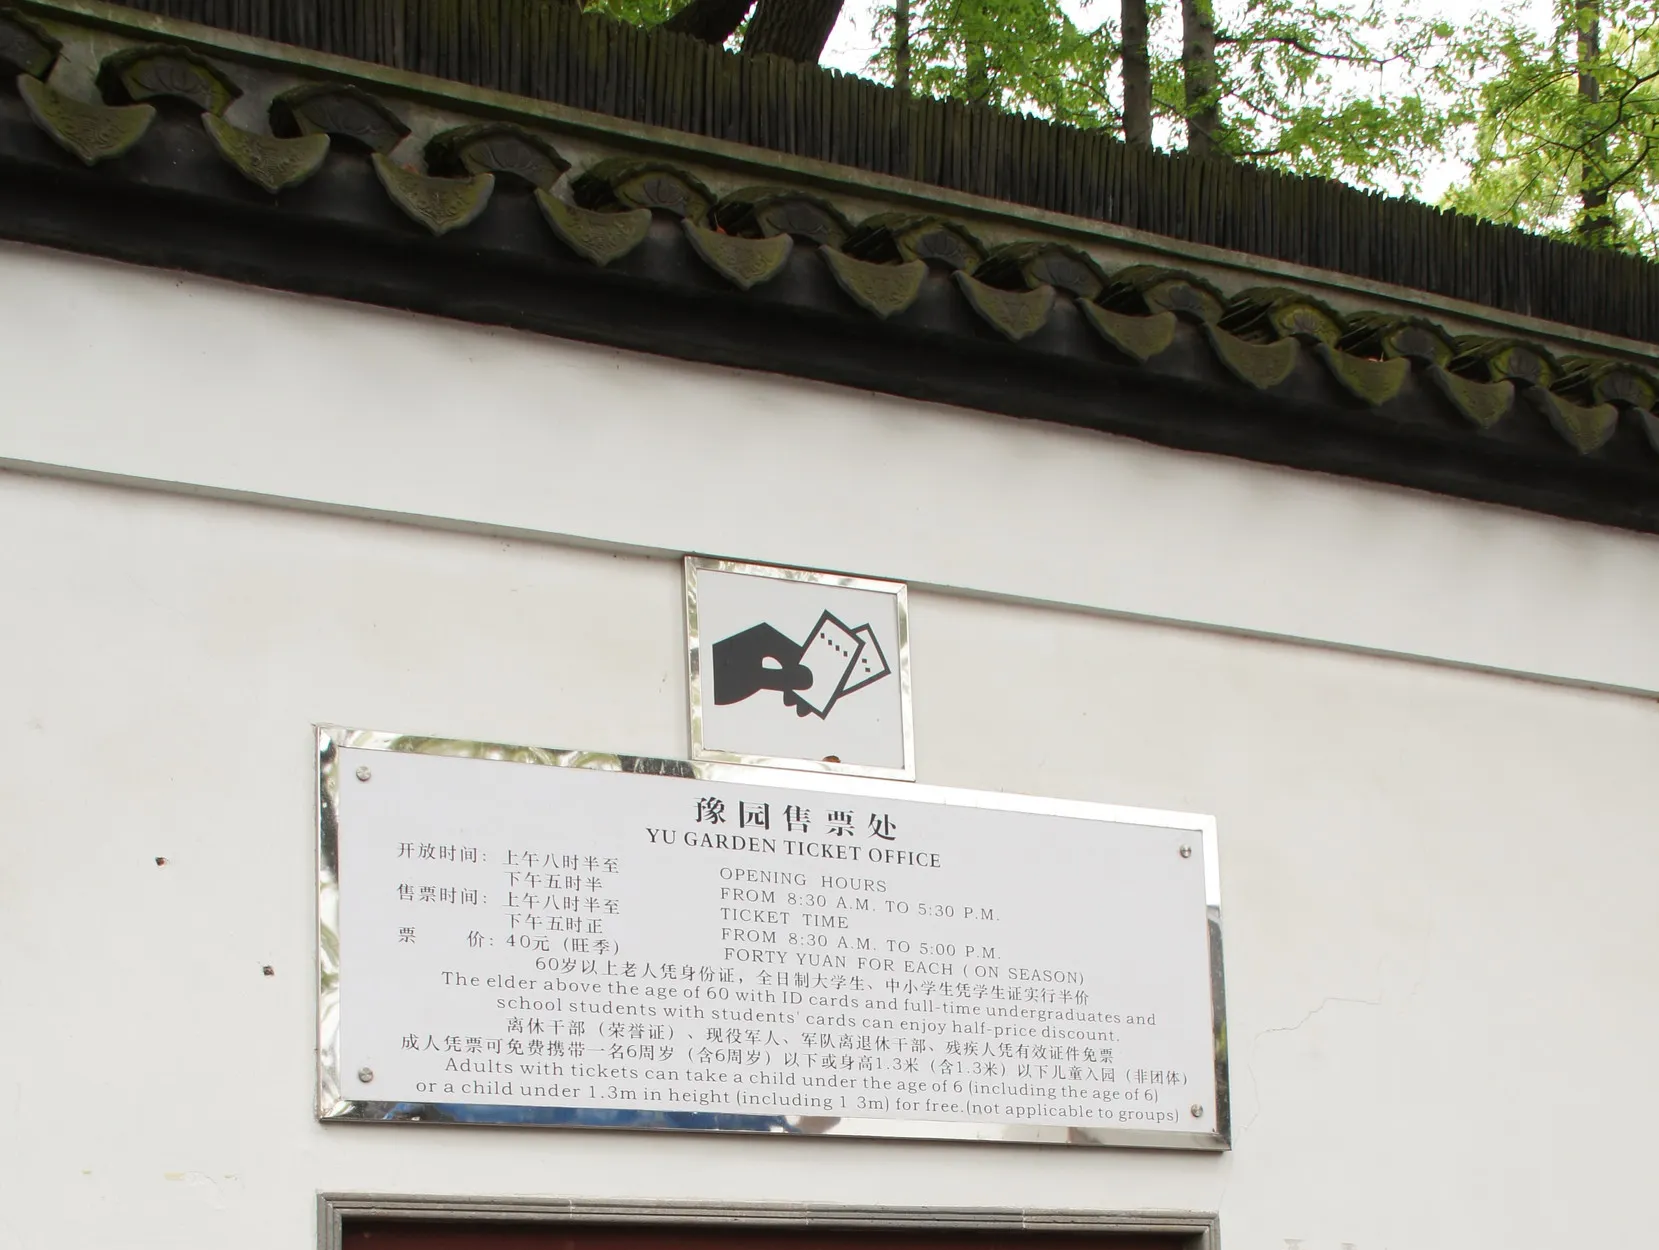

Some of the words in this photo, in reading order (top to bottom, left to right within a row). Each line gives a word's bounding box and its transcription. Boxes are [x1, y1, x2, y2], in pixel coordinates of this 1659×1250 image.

[693, 796, 897, 841] 豫园售票处
[503, 849, 619, 874] 上午八时半至
[645, 827, 677, 845] YU
[684, 831, 777, 854] GARDEN
[783, 839, 862, 861] TICKET
[868, 847, 941, 868] OFFICE
[504, 871, 603, 893] 下午五时半
[719, 867, 807, 886] OPENING
[821, 875, 888, 893] HOURS
[502, 891, 620, 915] 上午八时半至
[720, 887, 775, 904] FROM
[787, 892, 827, 908] 8:30
[836, 896, 875, 911] A.M.
[884, 900, 909, 914] TO
[918, 903, 954, 918] 5:30
[964, 907, 999, 921] P.M.
[720, 907, 791, 925] TICKET
[802, 913, 849, 929] TIME
[505, 913, 603, 934] 下午五时正
[721, 927, 776, 944] FROM
[788, 932, 828, 947] 8:30
[837, 936, 876, 951] A.M.
[886, 939, 910, 953] TO
[919, 942, 956, 957] 5:00
[965, 945, 1001, 959] P.M.
[724, 946, 788, 964] FORTY
[796, 952, 848, 968] YUAN
[857, 957, 895, 972] FOR
[904, 960, 953, 976] EACH
[1008, 967, 1084, 986] SEASON)
[441, 971, 480, 987] The
[486, 974, 537, 991] elder
[543, 977, 602, 993] above
[607, 980, 639, 996] the
[645, 986, 678, 1000] age
[683, 985, 701, 999] of
[706, 986, 729, 1000] 60
[735, 987, 776, 1004] with
[782, 991, 803, 1006] ID
[809, 994, 859, 1008] cards
[865, 997, 898, 1011] and
[904, 997, 981, 1016] full-time
[984, 1004, 1121, 1024] undergraduates
[1126, 1013, 1156, 1026] and
[496, 995, 562, 1012] school
[568, 1000, 657, 1017] students
[663, 1004, 705, 1020] with
[806, 1013, 856, 1029] cards
[862, 1018, 894, 1029] can
[900, 1018, 947, 1035] enjoy
[951, 1019, 1037, 1039] half-price
[1039, 1023, 1119, 1042] discount.
[444, 1057, 513, 1074] Adults
[519, 1061, 564, 1076] with
[571, 1063, 640, 1080] tickets
[645, 1069, 679, 1081] can
[685, 1068, 728, 1084] take
[733, 1072, 744, 1084] a
[749, 1069, 796, 1086] child
[801, 1071, 857, 1088] under
[863, 1076, 892, 1090] the
[897, 1081, 927, 1095] age
[931, 1079, 948, 1093] of
[953, 1080, 963, 1093] 6
[969, 1080, 1057, 1101] (including
[1061, 1085, 1088, 1099] the
[1092, 1089, 1120, 1103] age
[1124, 1087, 1139, 1101] of
[1144, 1088, 1158, 1104] 6)
[416, 1082, 438, 1093] or
[443, 1082, 455, 1094] a
[461, 1080, 514, 1096] child
[519, 1083, 581, 1098] under
[589, 1085, 637, 1100] 1.3m
[643, 1087, 662, 1101] in
[668, 1087, 731, 1106] height
[736, 1089, 833, 1111] (including
[895, 1097, 921, 1112] for
[1005, 1103, 1094, 1119] applicable
[1098, 1106, 1113, 1119] to
[1118, 1109, 1179, 1124] groups)
